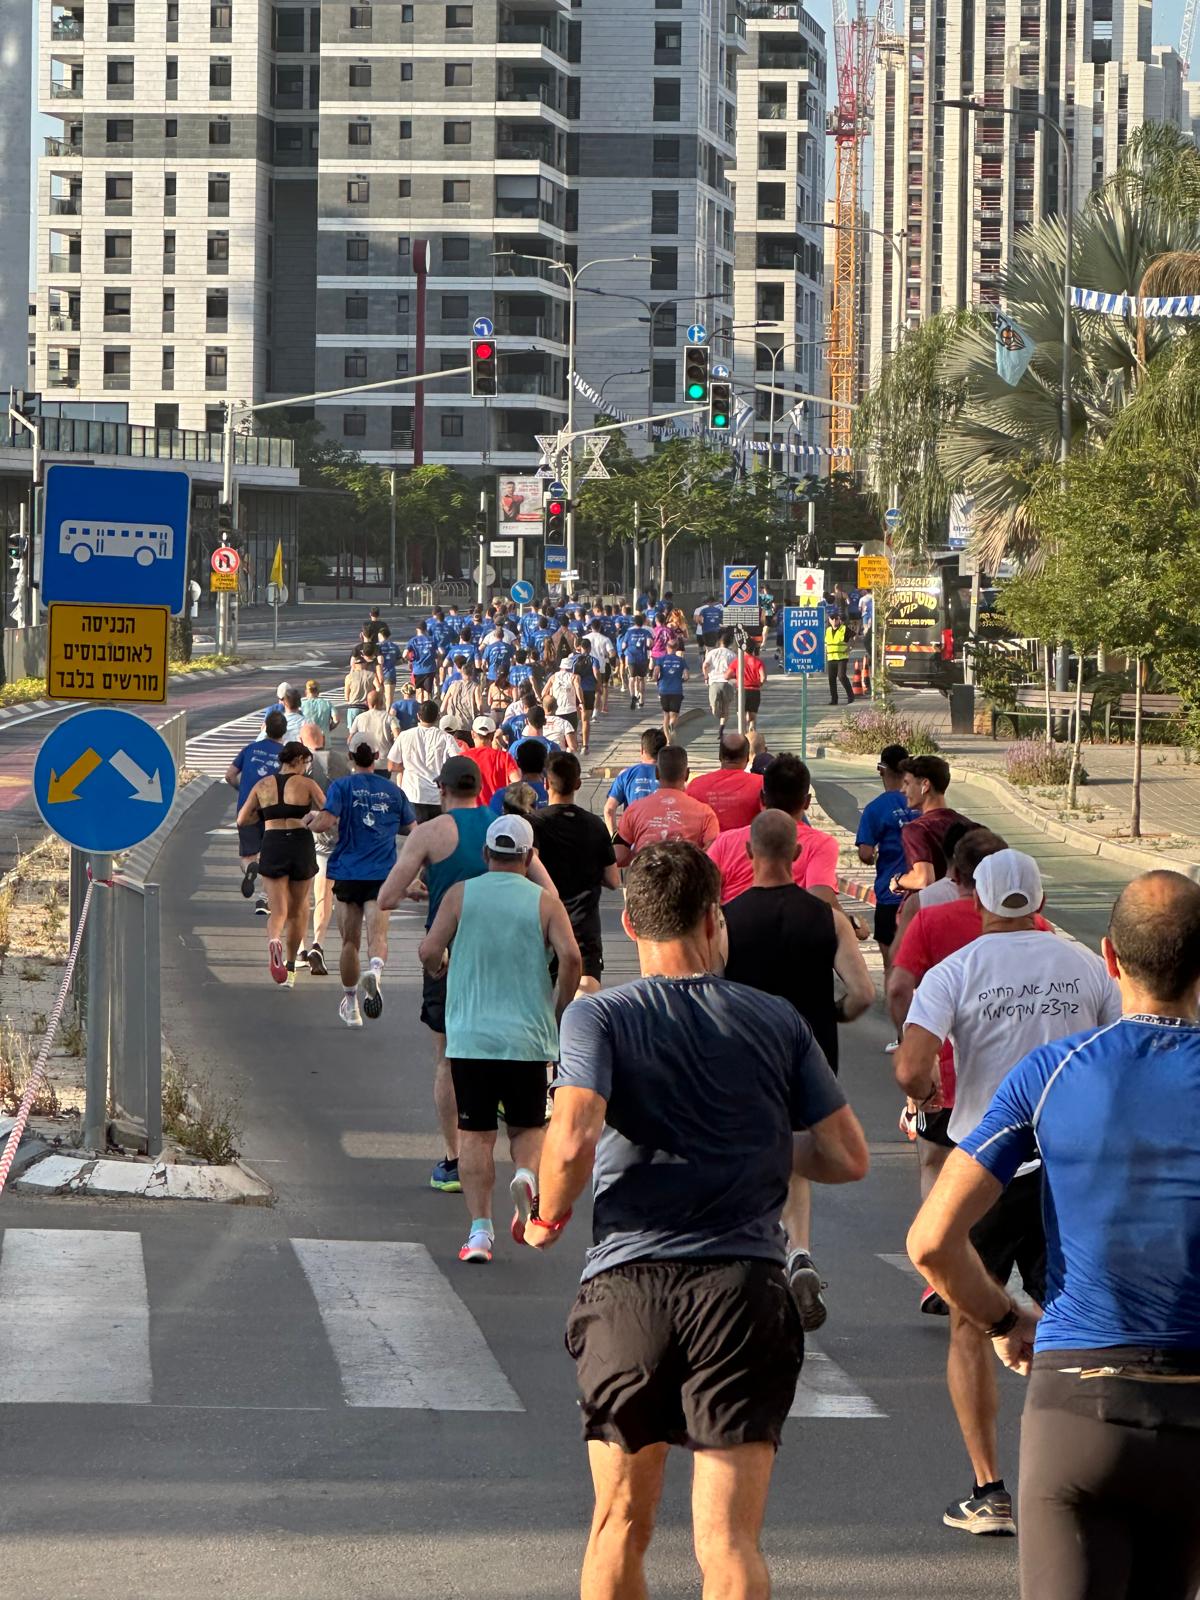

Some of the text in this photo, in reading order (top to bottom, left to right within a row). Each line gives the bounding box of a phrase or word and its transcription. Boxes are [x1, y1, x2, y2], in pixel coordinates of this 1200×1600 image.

[791, 610, 818, 618] תחנת
[899, 602, 918, 618] VIP
[82, 615, 136, 634] הכניסה
[790, 619, 819, 627] מוניות
[63, 643, 152, 663] לאוטובוסים
[56, 669, 158, 691] מורשים בלבד
[978, 978, 1080, 1002] לחיות את החיים
[983, 998, 1079, 1022] בקצב מקסימלי
